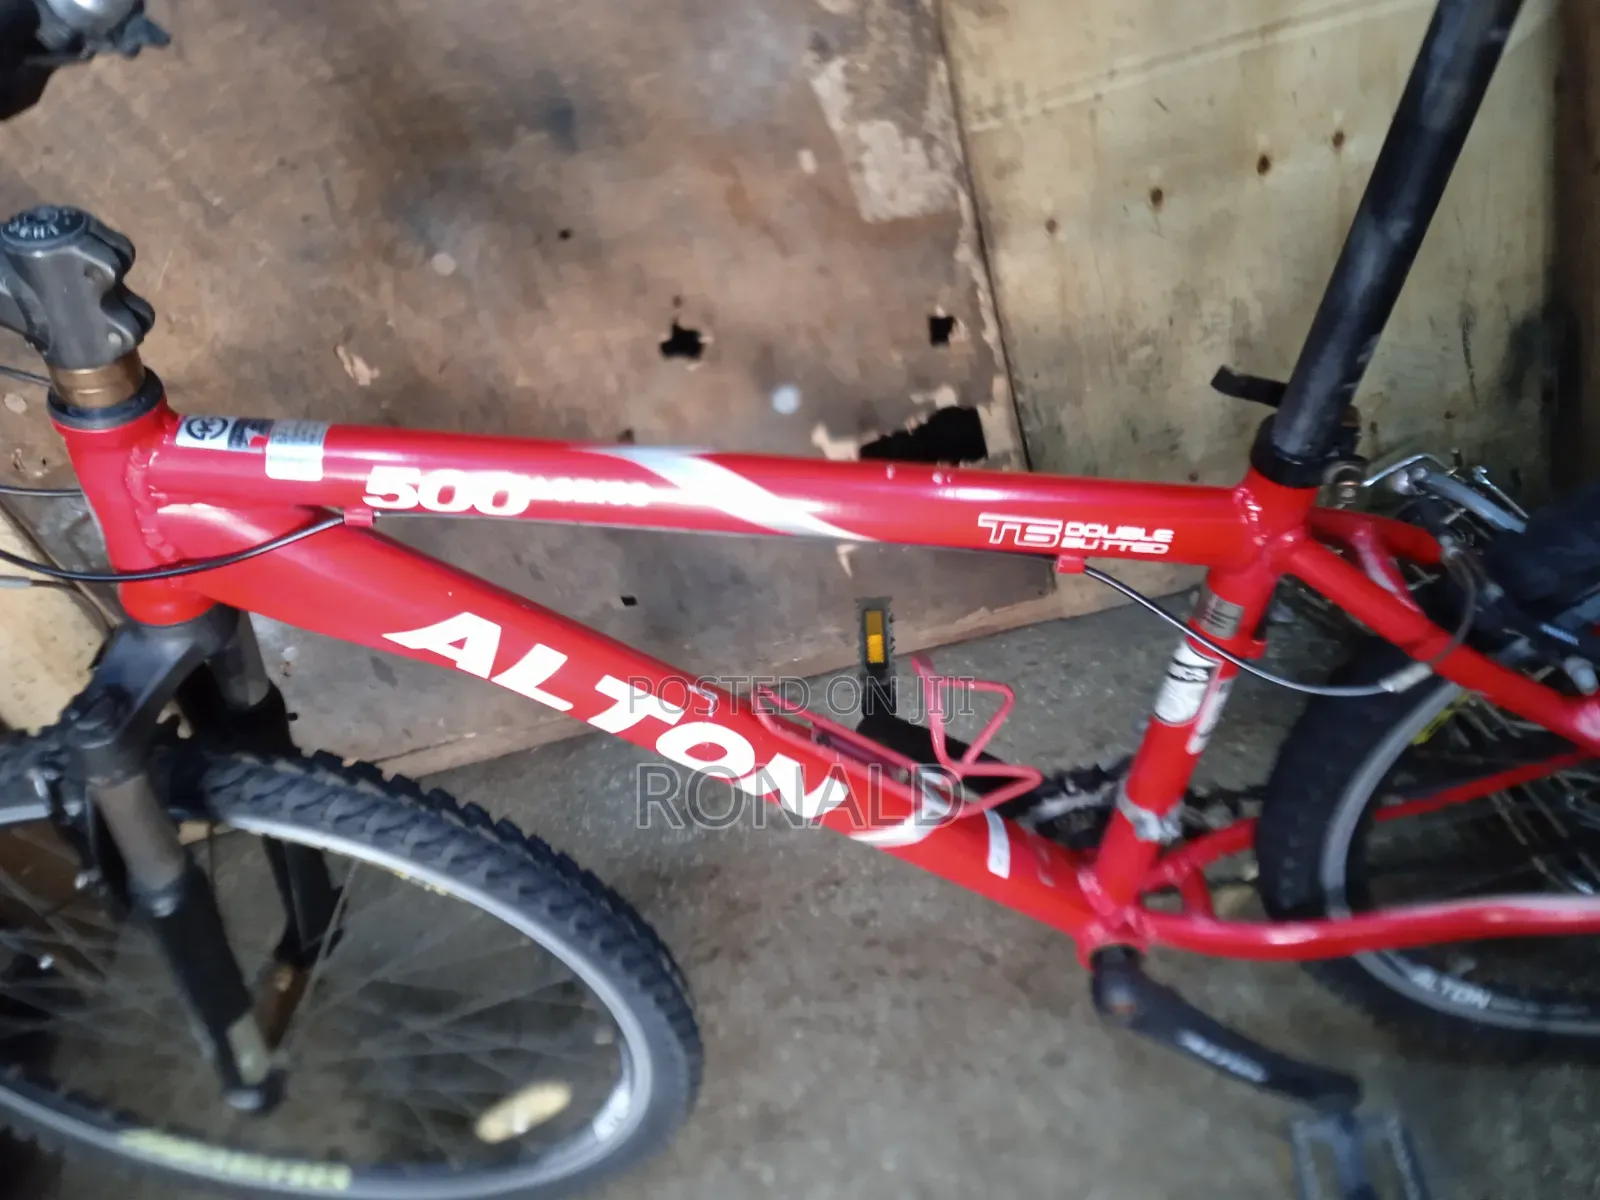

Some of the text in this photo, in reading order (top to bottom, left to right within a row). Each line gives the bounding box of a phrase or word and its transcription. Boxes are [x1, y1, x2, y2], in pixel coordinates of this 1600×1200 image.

[363, 466, 530, 516] 500
[1060, 537, 1169, 554] BUTTED
[1065, 521, 1174, 542] DOUBLE
[382, 612, 849, 819] ALTON
